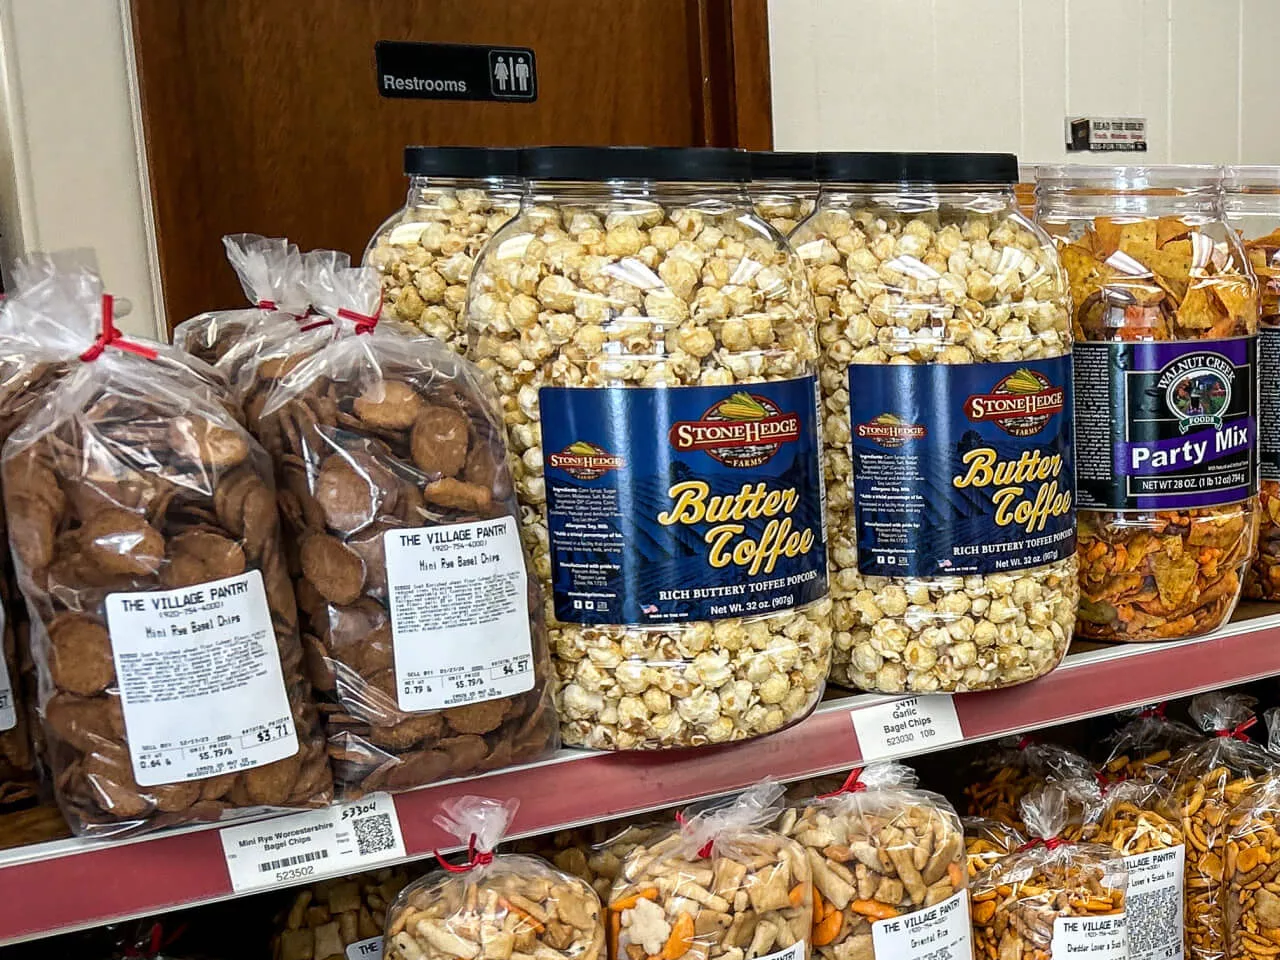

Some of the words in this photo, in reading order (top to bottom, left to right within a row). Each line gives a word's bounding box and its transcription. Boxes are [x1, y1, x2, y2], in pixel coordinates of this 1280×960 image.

[384, 75, 466, 94] Restrooms
[1158, 357, 1204, 390] WALNUT
[1206, 356, 1235, 383] CREEK
[1189, 416, 1215, 425] FOODS
[1132, 439, 1207, 469] Party
[1215, 425, 1248, 452] Mix
[732, 457, 763, 468] FARMS
[953, 448, 1062, 488] Butter
[1142, 481, 1157, 489] NET
[1159, 480, 1172, 488] WT
[1173, 479, 1182, 488] 28
[657, 481, 799, 526] Butter
[992, 480, 1072, 533] Toffee
[400, 534, 422, 547] THE
[427, 529, 471, 544] VILLAGE
[475, 524, 508, 538] PANTRY
[704, 517, 814, 576] Toffee
[953, 545, 978, 555] RICH
[981, 541, 1023, 553] BUTTERY
[1026, 535, 1052, 549] TOFFEE
[419, 558, 438, 572] Mini
[659, 589, 690, 601] RICH
[693, 584, 746, 598] BUTTERY
[749, 578, 785, 593] TOFFEE
[786, 569, 818, 587] POPCORN
[121, 599, 146, 613] THE
[151, 592, 204, 610] VILLAGE
[208, 582, 249, 603] PANTRY
[710, 604, 728, 616] Net
[728, 602, 745, 614] Wt.
[746, 601, 757, 612] 32
[145, 627, 167, 639] Mini
[503, 660, 529, 675] $4.57
[893, 708, 917, 720] Garlic
[257, 724, 290, 742] $3.71
[884, 721, 907, 734] Bagel
[908, 717, 932, 730] Chips
[342, 802, 376, 820] 53304
[239, 835, 256, 848] Mini
[258, 833, 273, 846] Rye
[275, 822, 333, 840] Worcestershire
[264, 839, 287, 851] Bagel
[289, 835, 311, 847] Chips
[1153, 851, 1176, 866] PANTRY
[276, 866, 314, 882] 523502
[883, 923, 900, 934] THE
[904, 910, 937, 928] VILLAGE
[940, 898, 961, 917] PANTRY
[1083, 921, 1112, 932] VILLAGE
